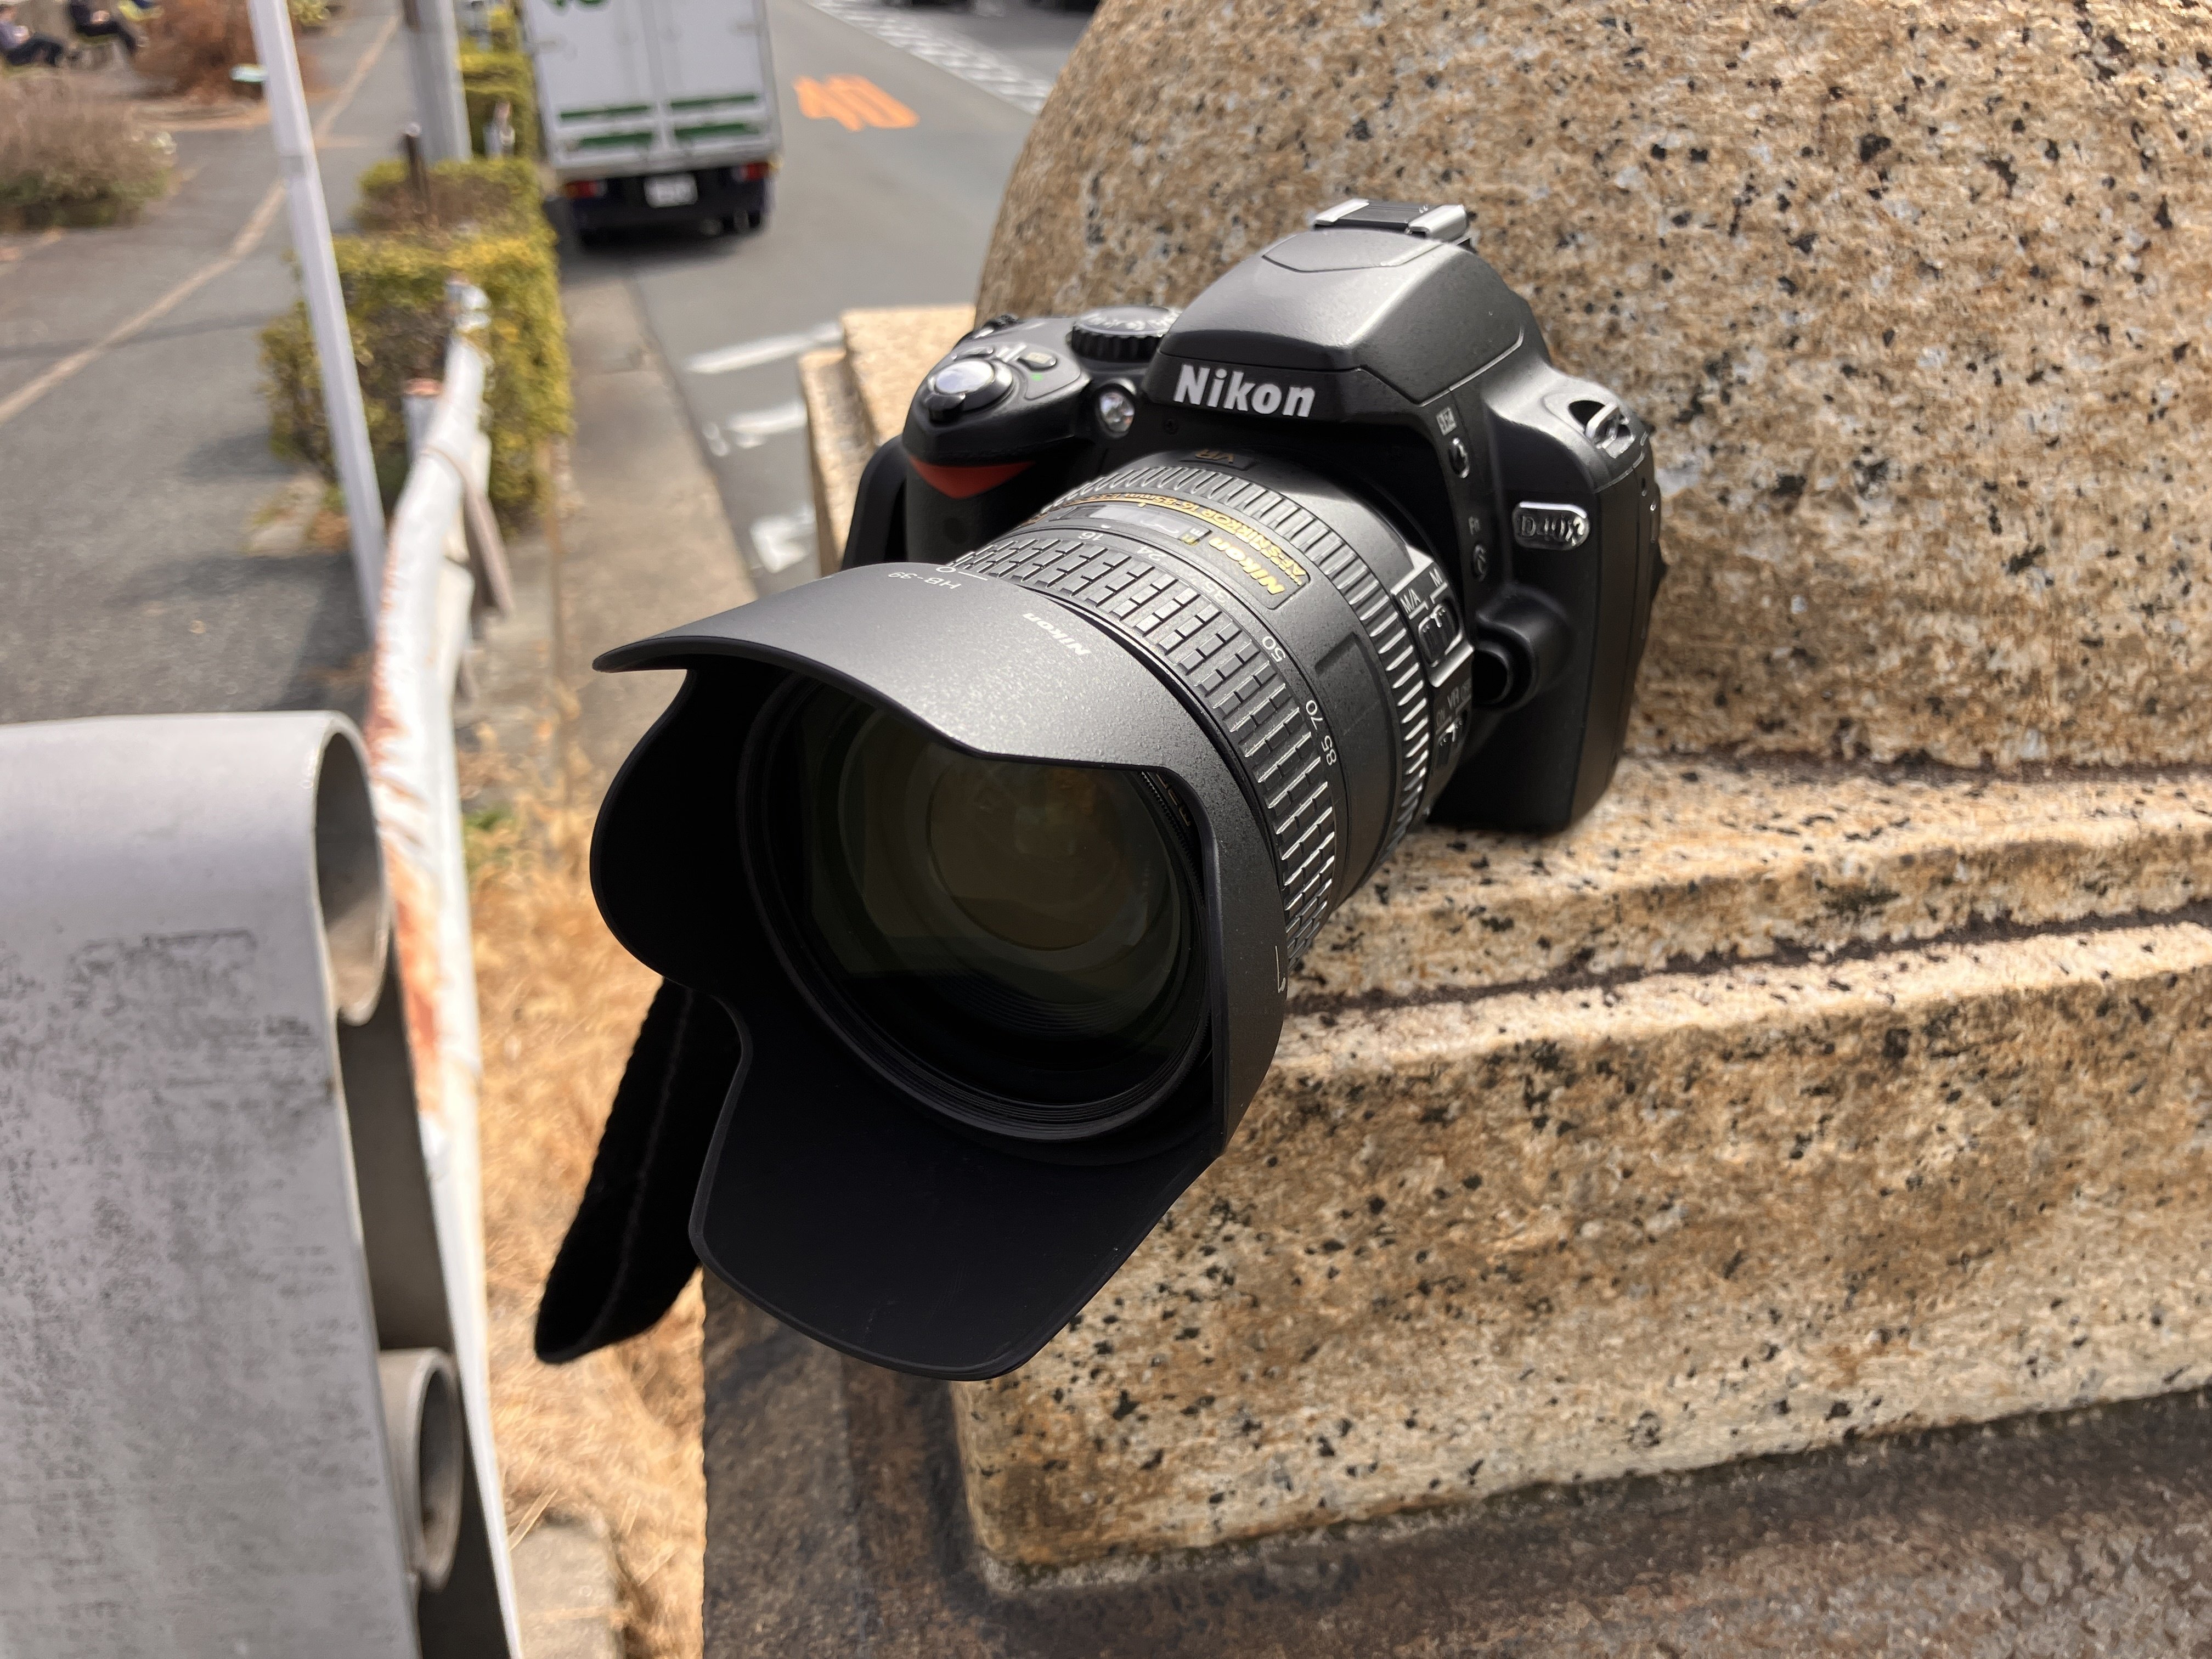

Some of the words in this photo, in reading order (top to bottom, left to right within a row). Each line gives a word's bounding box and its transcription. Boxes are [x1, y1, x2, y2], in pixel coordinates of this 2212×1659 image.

[1173, 364, 1316, 417] Nikon
[1124, 493, 1200, 512] 16-85mm
[1077, 531, 1104, 541] 16
[1201, 506, 1272, 550] NIKKOR
[1137, 546, 1167, 562] 24
[1209, 537, 1285, 595] Nikon
[1268, 545, 1306, 576] AF-S
[888, 571, 962, 590] HB-39
[1429, 568, 1443, 587] M
[1201, 581, 1231, 603] 35
[1400, 588, 1421, 613] M/A
[1023, 613, 1090, 656] Nikon
[1262, 636, 1286, 662] 50
[1306, 700, 1323, 729] 70
[1321, 735, 1337, 766] 85
